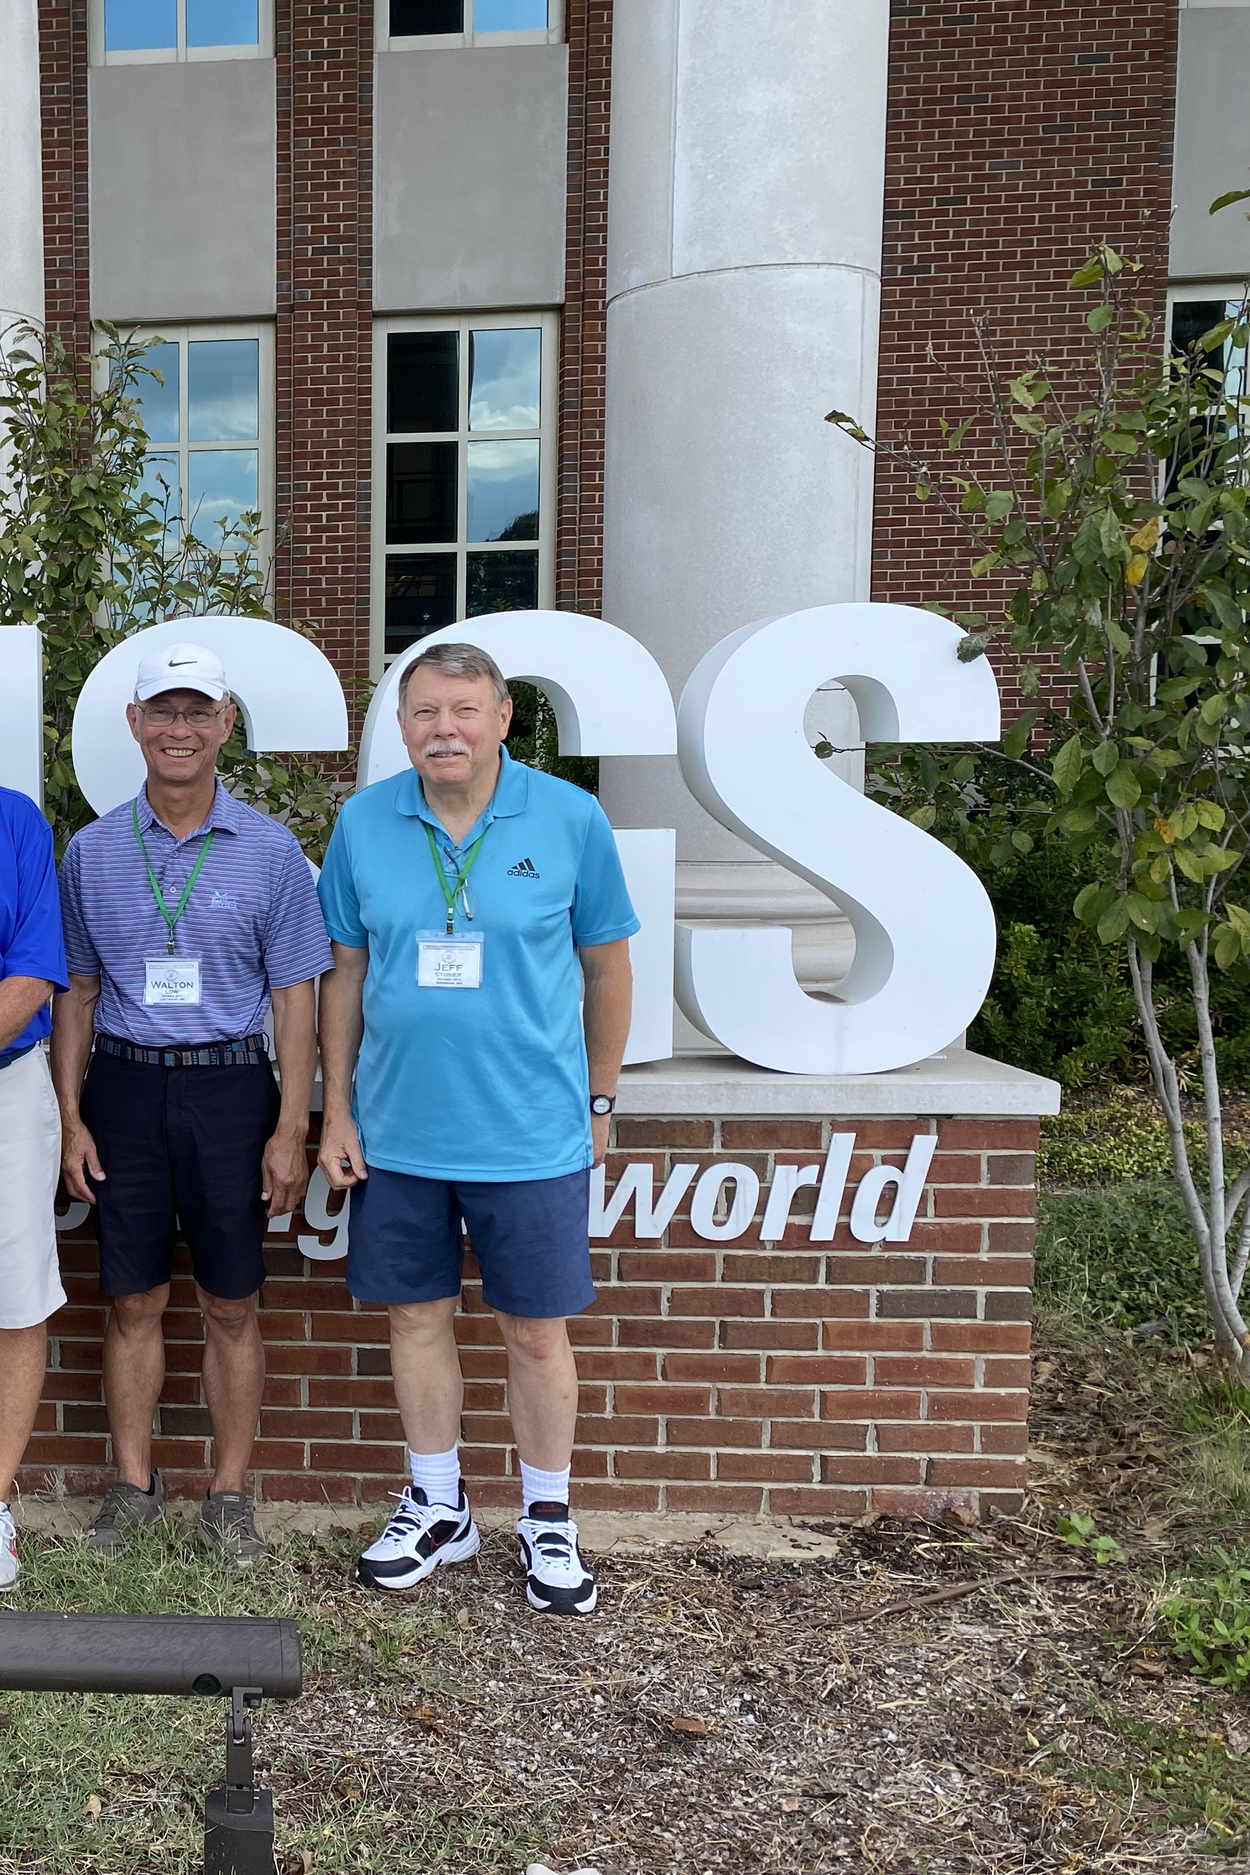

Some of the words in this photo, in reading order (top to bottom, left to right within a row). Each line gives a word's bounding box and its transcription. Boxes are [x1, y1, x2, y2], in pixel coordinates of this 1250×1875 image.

[506, 869, 540, 879] adidas
[434, 963, 463, 971] JEFF
[151, 981, 194, 989] WALTON
[588, 1132, 939, 1243] world
